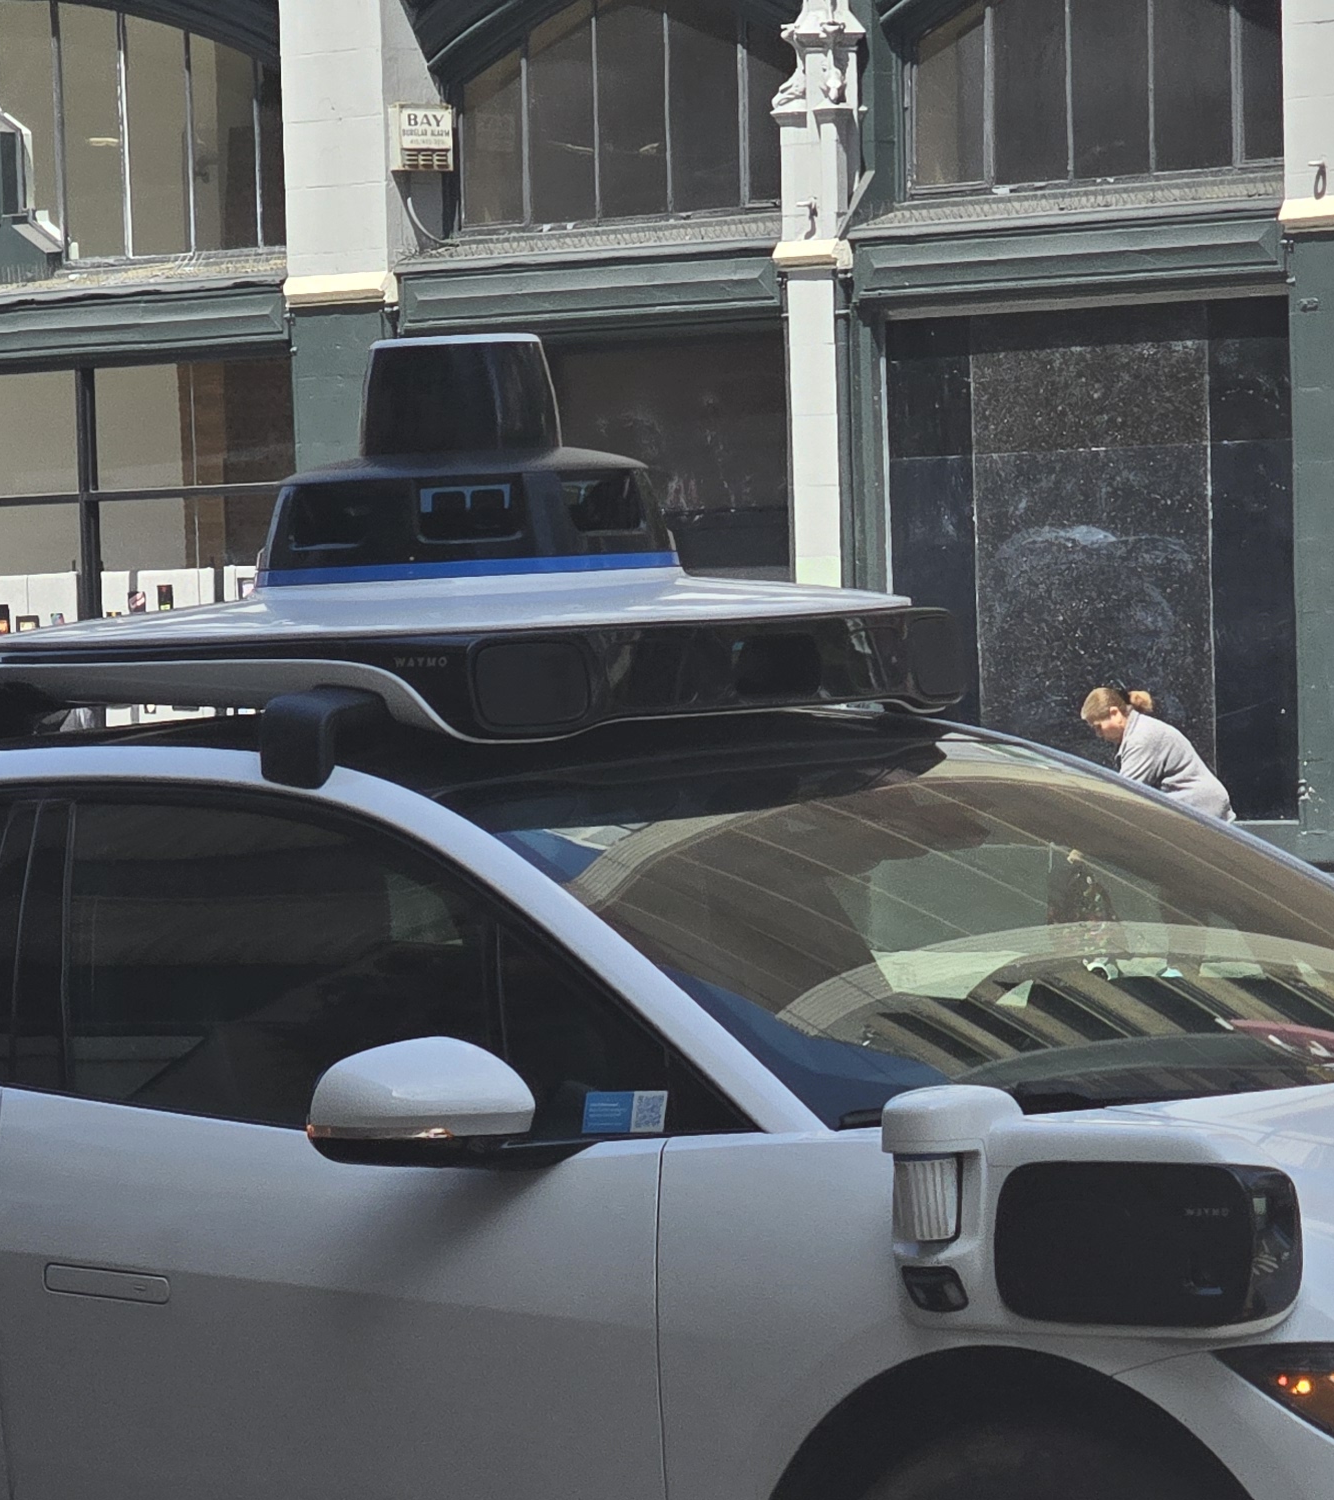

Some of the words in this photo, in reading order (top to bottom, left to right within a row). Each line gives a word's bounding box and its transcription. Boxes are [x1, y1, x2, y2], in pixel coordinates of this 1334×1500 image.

[407, 113, 444, 127] BAY
[431, 129, 450, 137] ALARM
[393, 656, 448, 667] WAYMO
